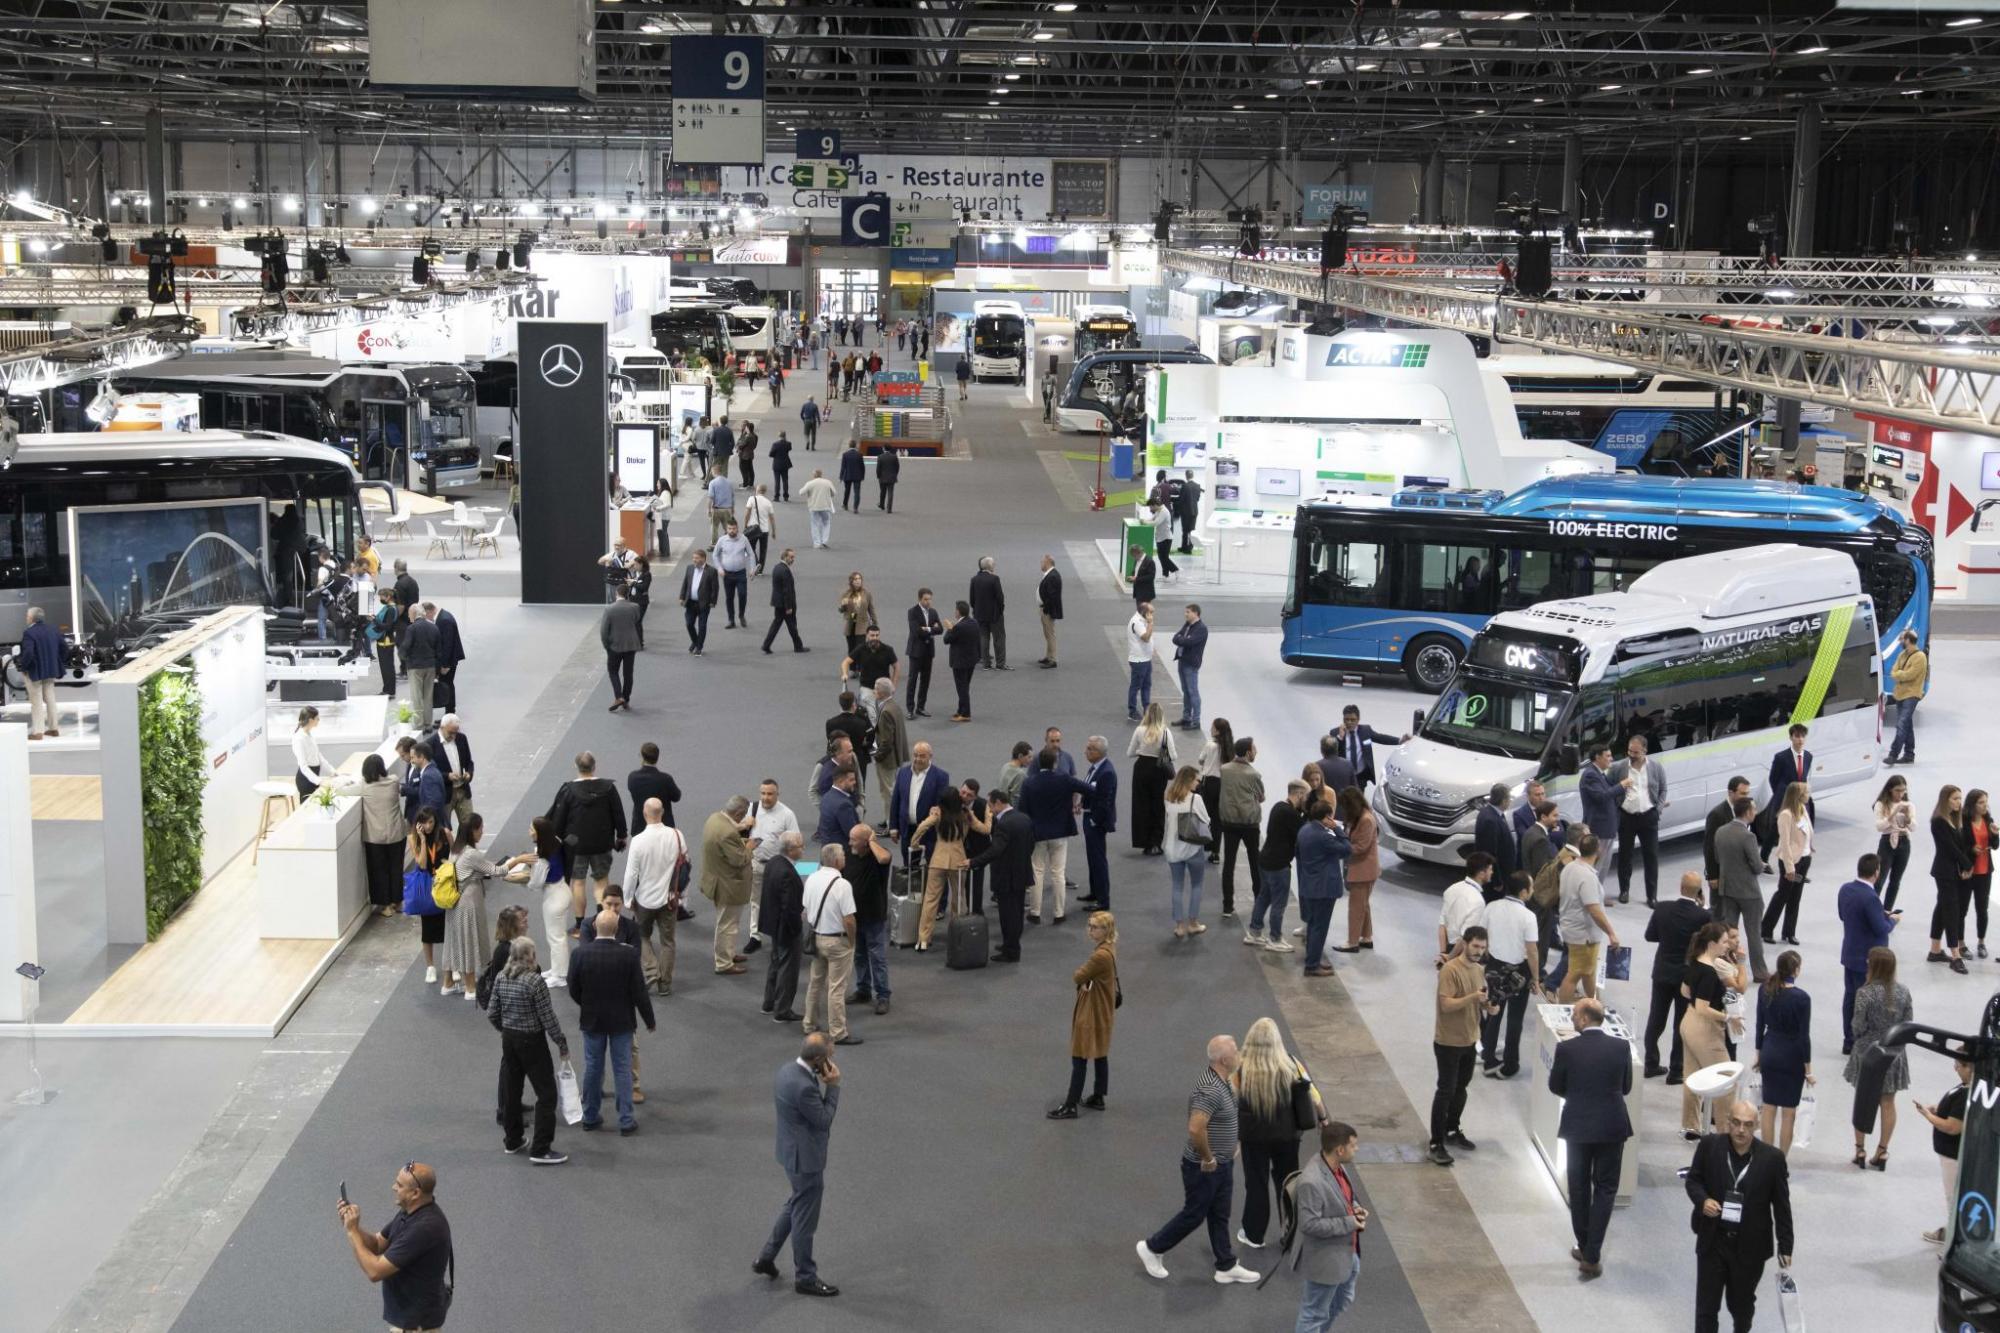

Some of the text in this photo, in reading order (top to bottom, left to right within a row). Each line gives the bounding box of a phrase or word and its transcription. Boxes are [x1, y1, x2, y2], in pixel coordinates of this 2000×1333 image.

[723, 50, 750, 91] 9
[820, 136, 834, 156] 9
[845, 157, 856, 173] 9
[903, 166, 1045, 188] Restaurante
[1310, 190, 1367, 202] FORUM
[852, 203, 881, 240] C
[1655, 203, 1668, 219] D
[1606, 433, 1646, 443] ZERO
[1547, 520, 1679, 541] 100% ELECTRIC
[1702, 617, 1822, 650] NATURAL GAS
[1505, 644, 1537, 670] GNC
